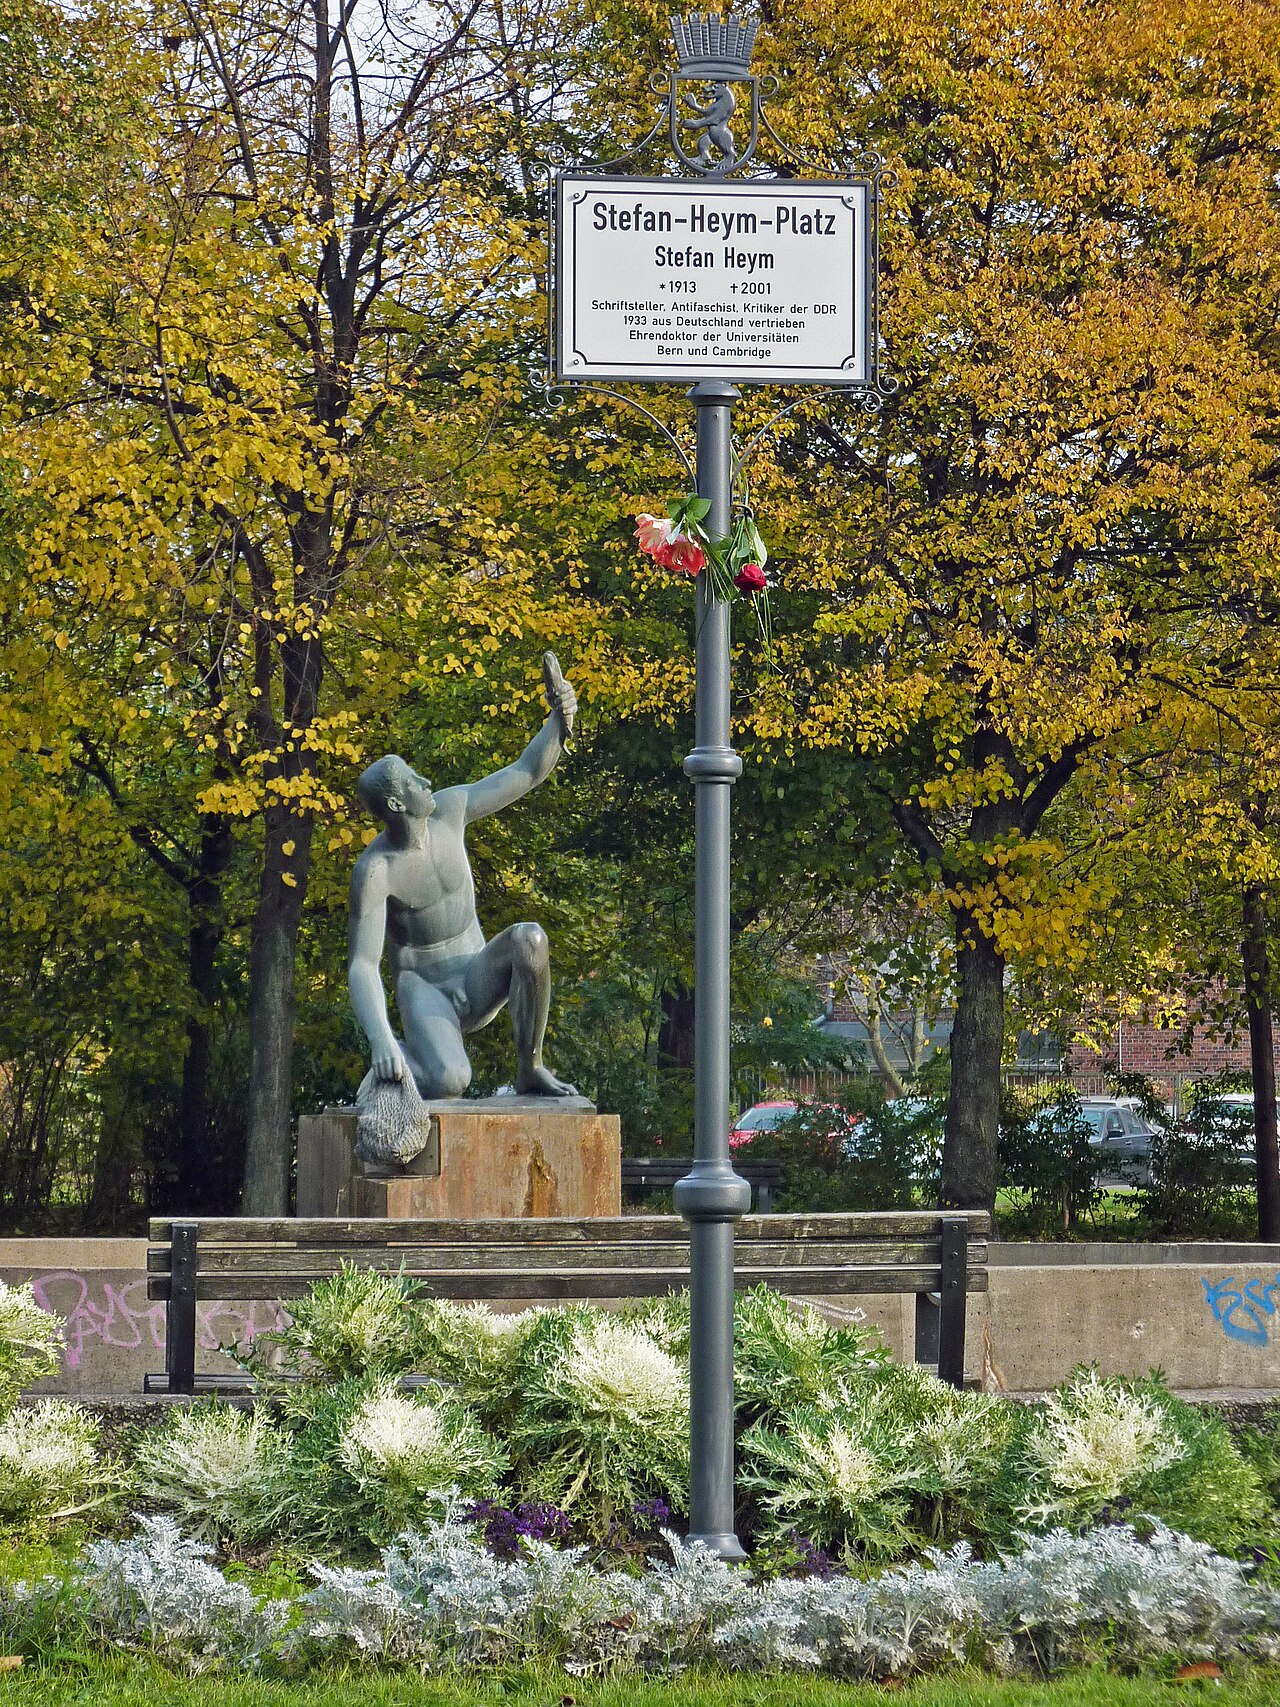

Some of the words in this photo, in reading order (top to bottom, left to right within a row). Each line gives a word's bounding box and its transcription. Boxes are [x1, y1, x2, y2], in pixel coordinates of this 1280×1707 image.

[592, 202, 836, 241] Stefan-Heym-Platz
[655, 245, 714, 268] Stefan
[724, 246, 774, 275] Heym
[743, 303, 785, 313] Kritiker
[790, 304, 809, 314] der
[814, 304, 837, 315] DDR
[624, 315, 647, 325] 1933
[652, 318, 672, 326] aus
[677, 316, 744, 327] Deutschland
[749, 318, 805, 329] vertrieben
[629, 330, 698, 341] Ehrendoktor
[703, 331, 721, 341] der
[727, 332, 799, 343] Universitäten
[657, 345, 683, 355] Bern
[688, 346, 707, 356] und
[712, 346, 771, 360] Cambridge
